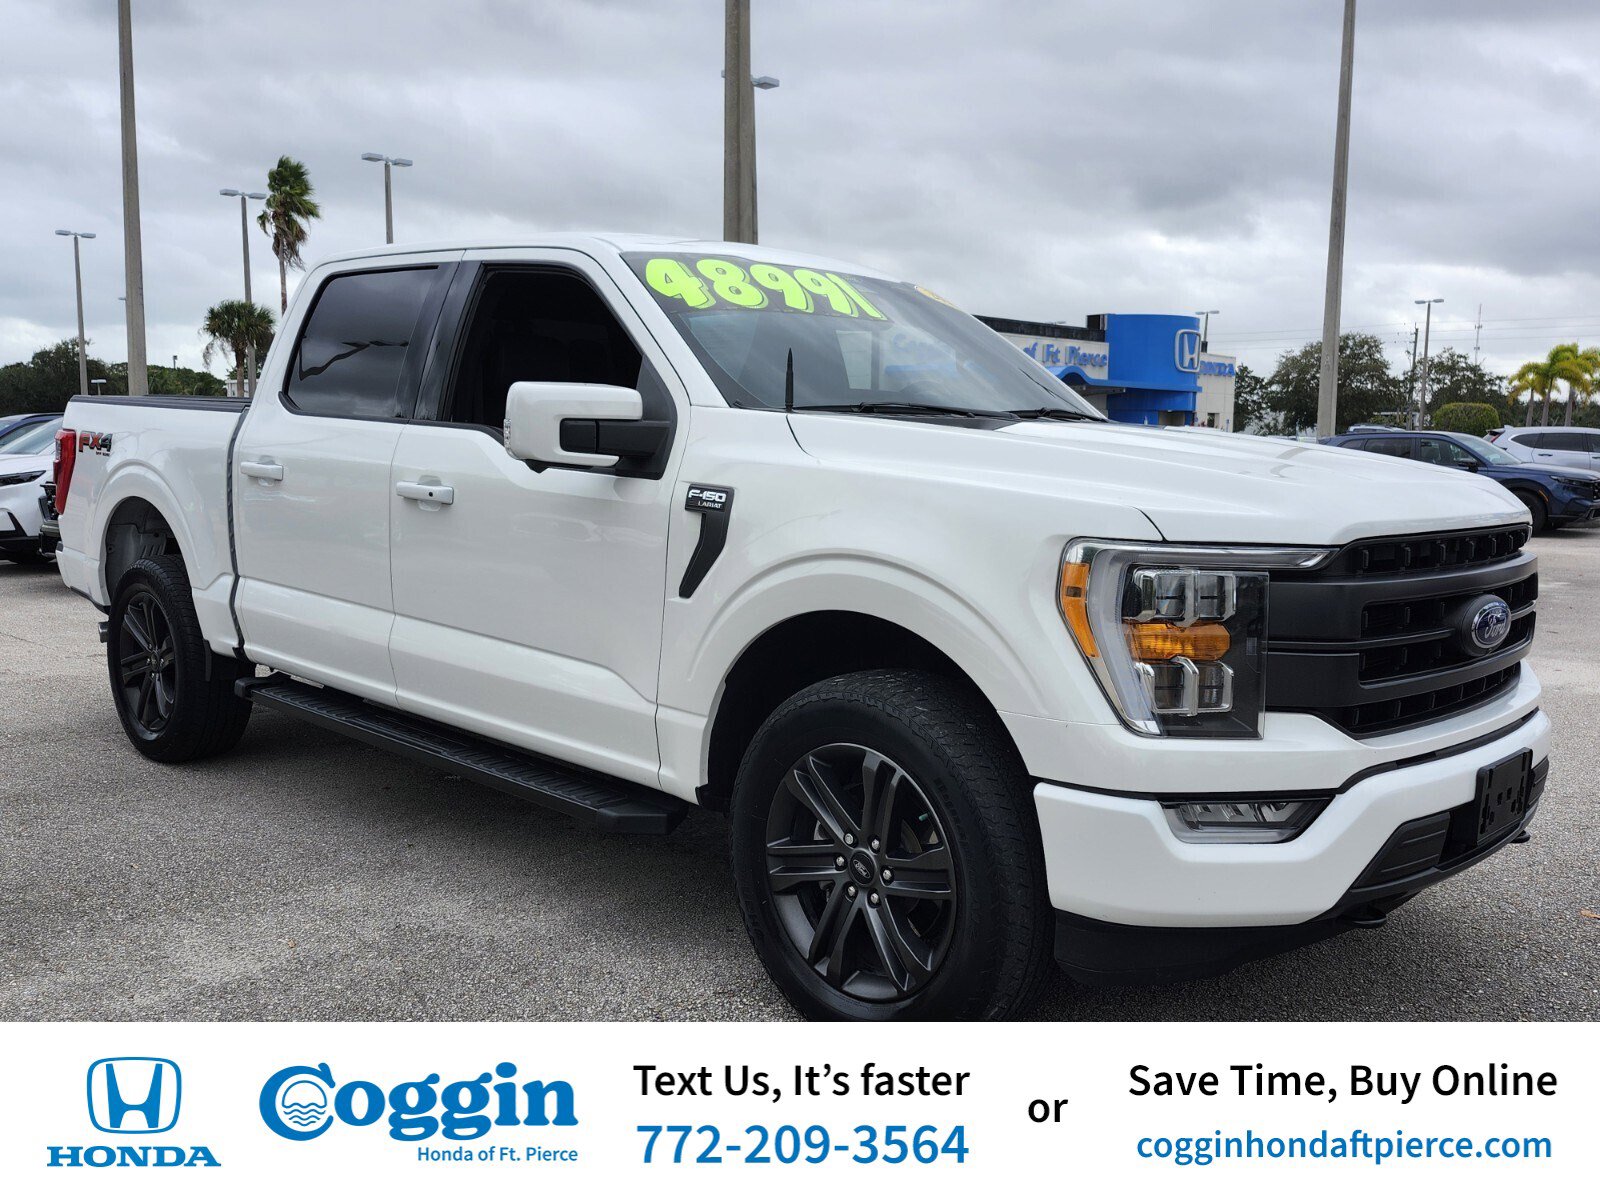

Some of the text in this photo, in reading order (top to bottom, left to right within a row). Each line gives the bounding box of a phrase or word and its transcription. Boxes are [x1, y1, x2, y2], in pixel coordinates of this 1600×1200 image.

[645, 258, 888, 322] 48991
[1066, 345, 1108, 367] Pierce
[1199, 361, 1235, 376] ONDA
[79, 430, 113, 452] FX4
[688, 489, 727, 503] F-150
[697, 500, 722, 509] LARIAT
